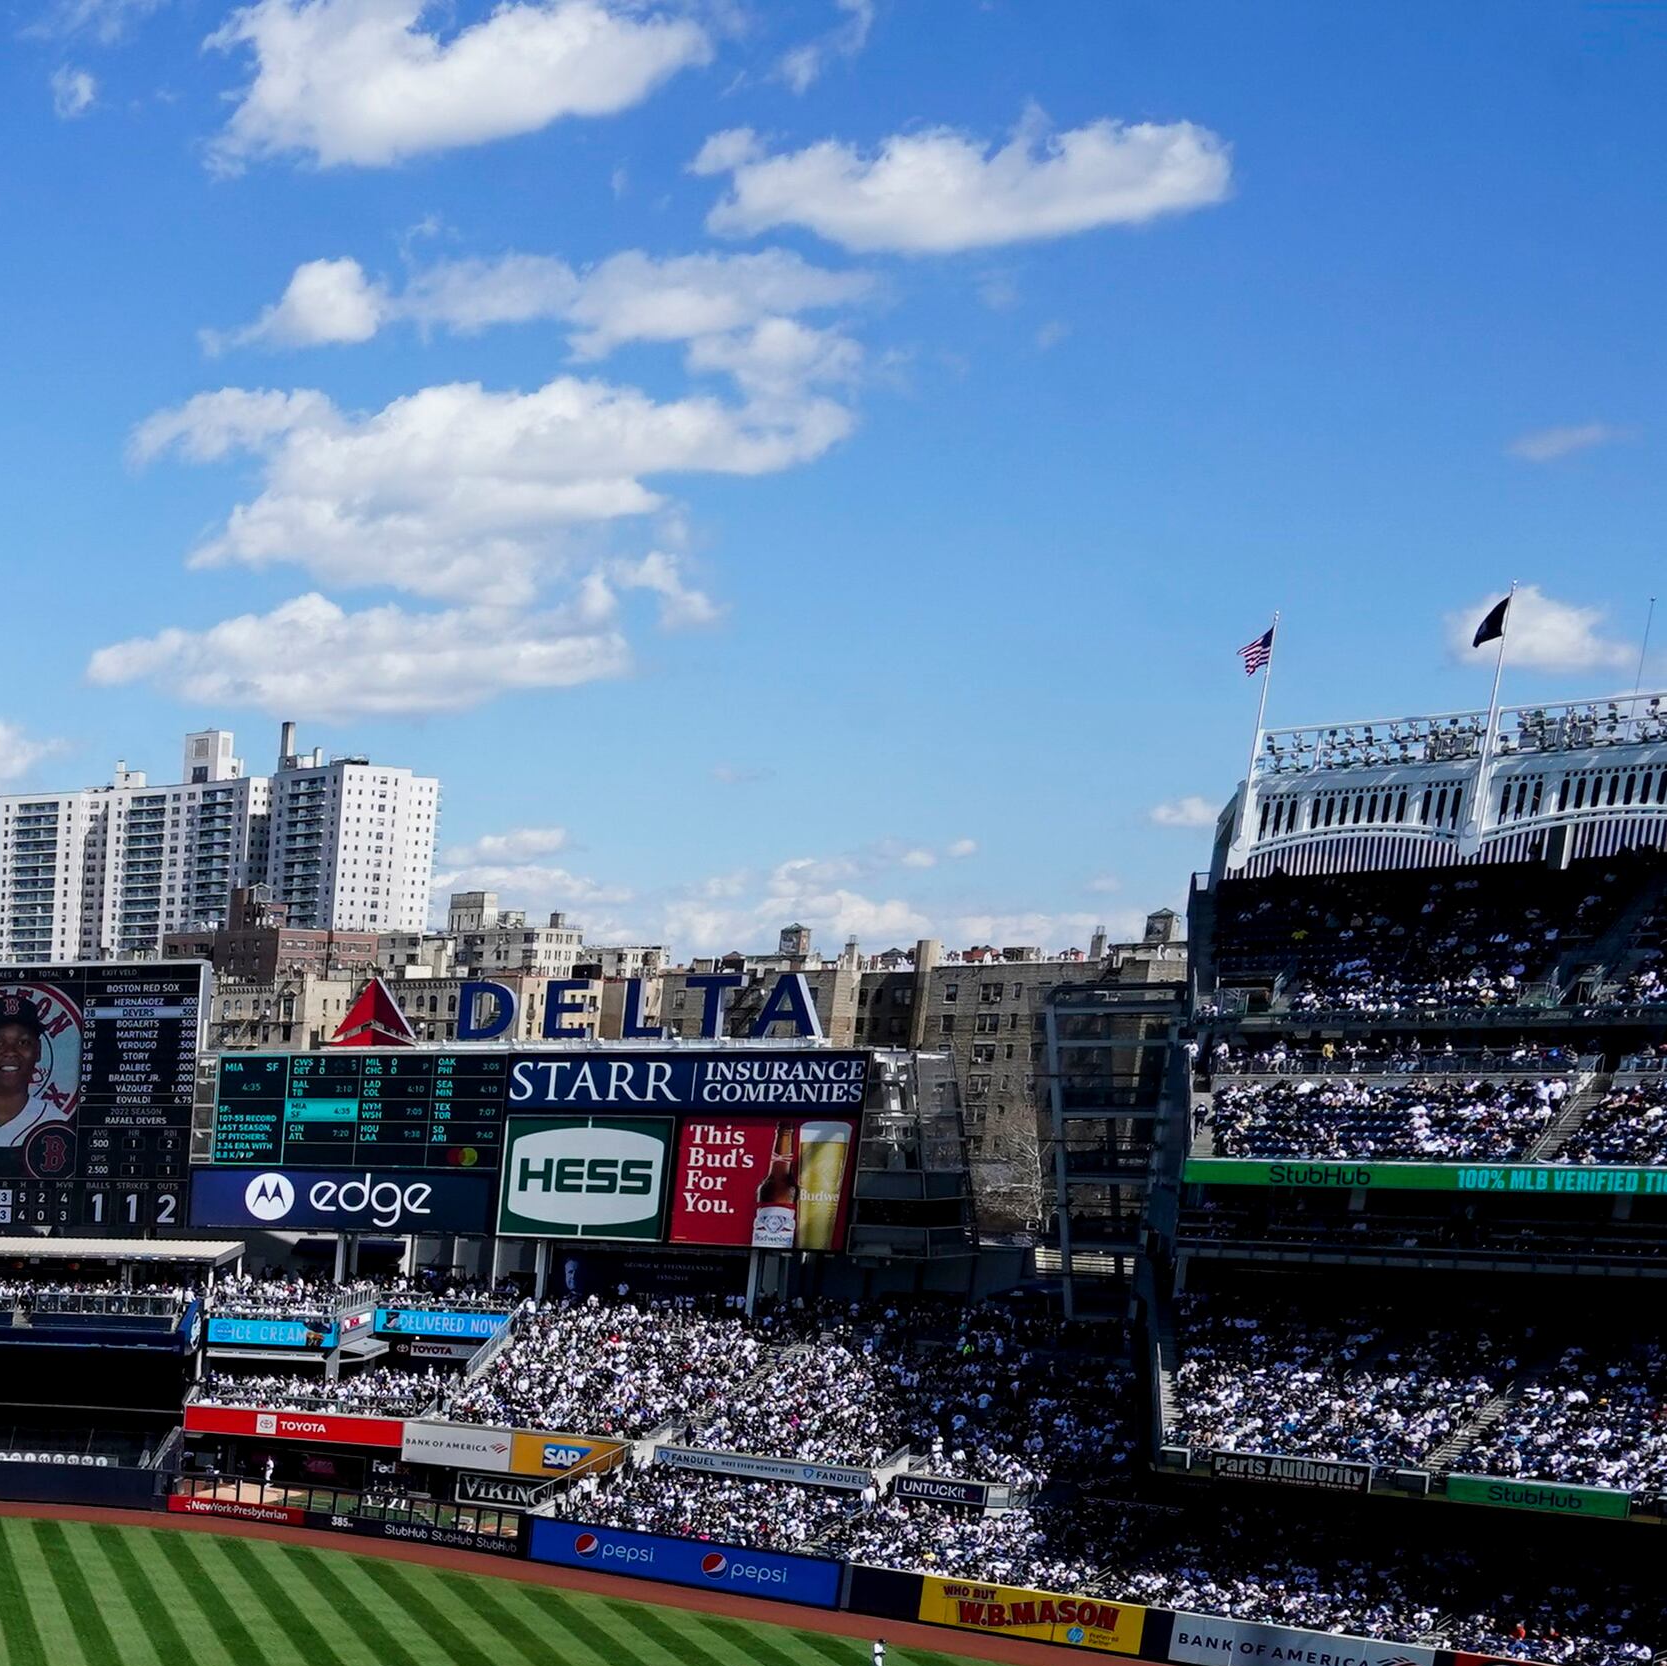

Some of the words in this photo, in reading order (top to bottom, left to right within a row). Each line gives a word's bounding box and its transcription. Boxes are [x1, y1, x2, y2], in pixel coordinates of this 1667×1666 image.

[107, 985, 141, 993] BOSTON
[143, 984, 161, 992] RED
[162, 983, 180, 992] SOX
[457, 972, 823, 1040] DELTA
[704, 1061, 865, 1081] INSURANCE
[510, 1062, 681, 1101] STARR
[703, 1083, 863, 1103] COMPANIES
[105, 1117, 135, 1125] RAFAEL
[136, 1116, 167, 1124] DEVERS
[690, 1125, 745, 1145] This
[687, 1147, 754, 1168] Bud's
[518, 1157, 653, 1194] HESS
[686, 1170, 727, 1190] For
[1269, 1165, 1371, 1185] StubHub
[1457, 1169, 1504, 1189] 100%
[1510, 1171, 1548, 1190] MLB
[1554, 1171, 1637, 1191] VERIFIED
[92, 1193, 103, 1222] 1
[126, 1194, 137, 1223] 1
[156, 1194, 176, 1223] 2
[309, 1173, 431, 1227] edge
[683, 1193, 735, 1213] You.
[400, 1312, 466, 1334] DELIVERED
[231, 1326, 253, 1341] ICE
[259, 1326, 307, 1343] CREAM
[411, 1344, 454, 1355] TOYOTA
[280, 1421, 327, 1433] TOYOTA
[405, 1438, 431, 1448] BANK
[433, 1440, 444, 1449] OF
[445, 1442, 488, 1454] AMERICA
[543, 1446, 581, 1467] SAP
[671, 1453, 716, 1467] FANDUEL
[816, 1471, 865, 1485] FANDUEL
[1215, 1456, 1267, 1475] Parts
[1269, 1459, 1365, 1486] Authority
[902, 1481, 967, 1499] UNTUCKit
[1488, 1485, 1582, 1509] StubHub
[331, 1515, 349, 1527] 385
[385, 1524, 428, 1540] StubHub
[431, 1530, 473, 1546] StubHub
[475, 1536, 517, 1553] StubHub
[602, 1542, 655, 1562] pepsi
[730, 1561, 788, 1583] pepsi
[943, 1584, 970, 1598] WHO
[972, 1587, 997, 1600] BUT
[957, 1599, 1122, 1633] W.B.MASON
[1177, 1632, 1232, 1652] BANK
[1239, 1641, 1266, 1657] OF
